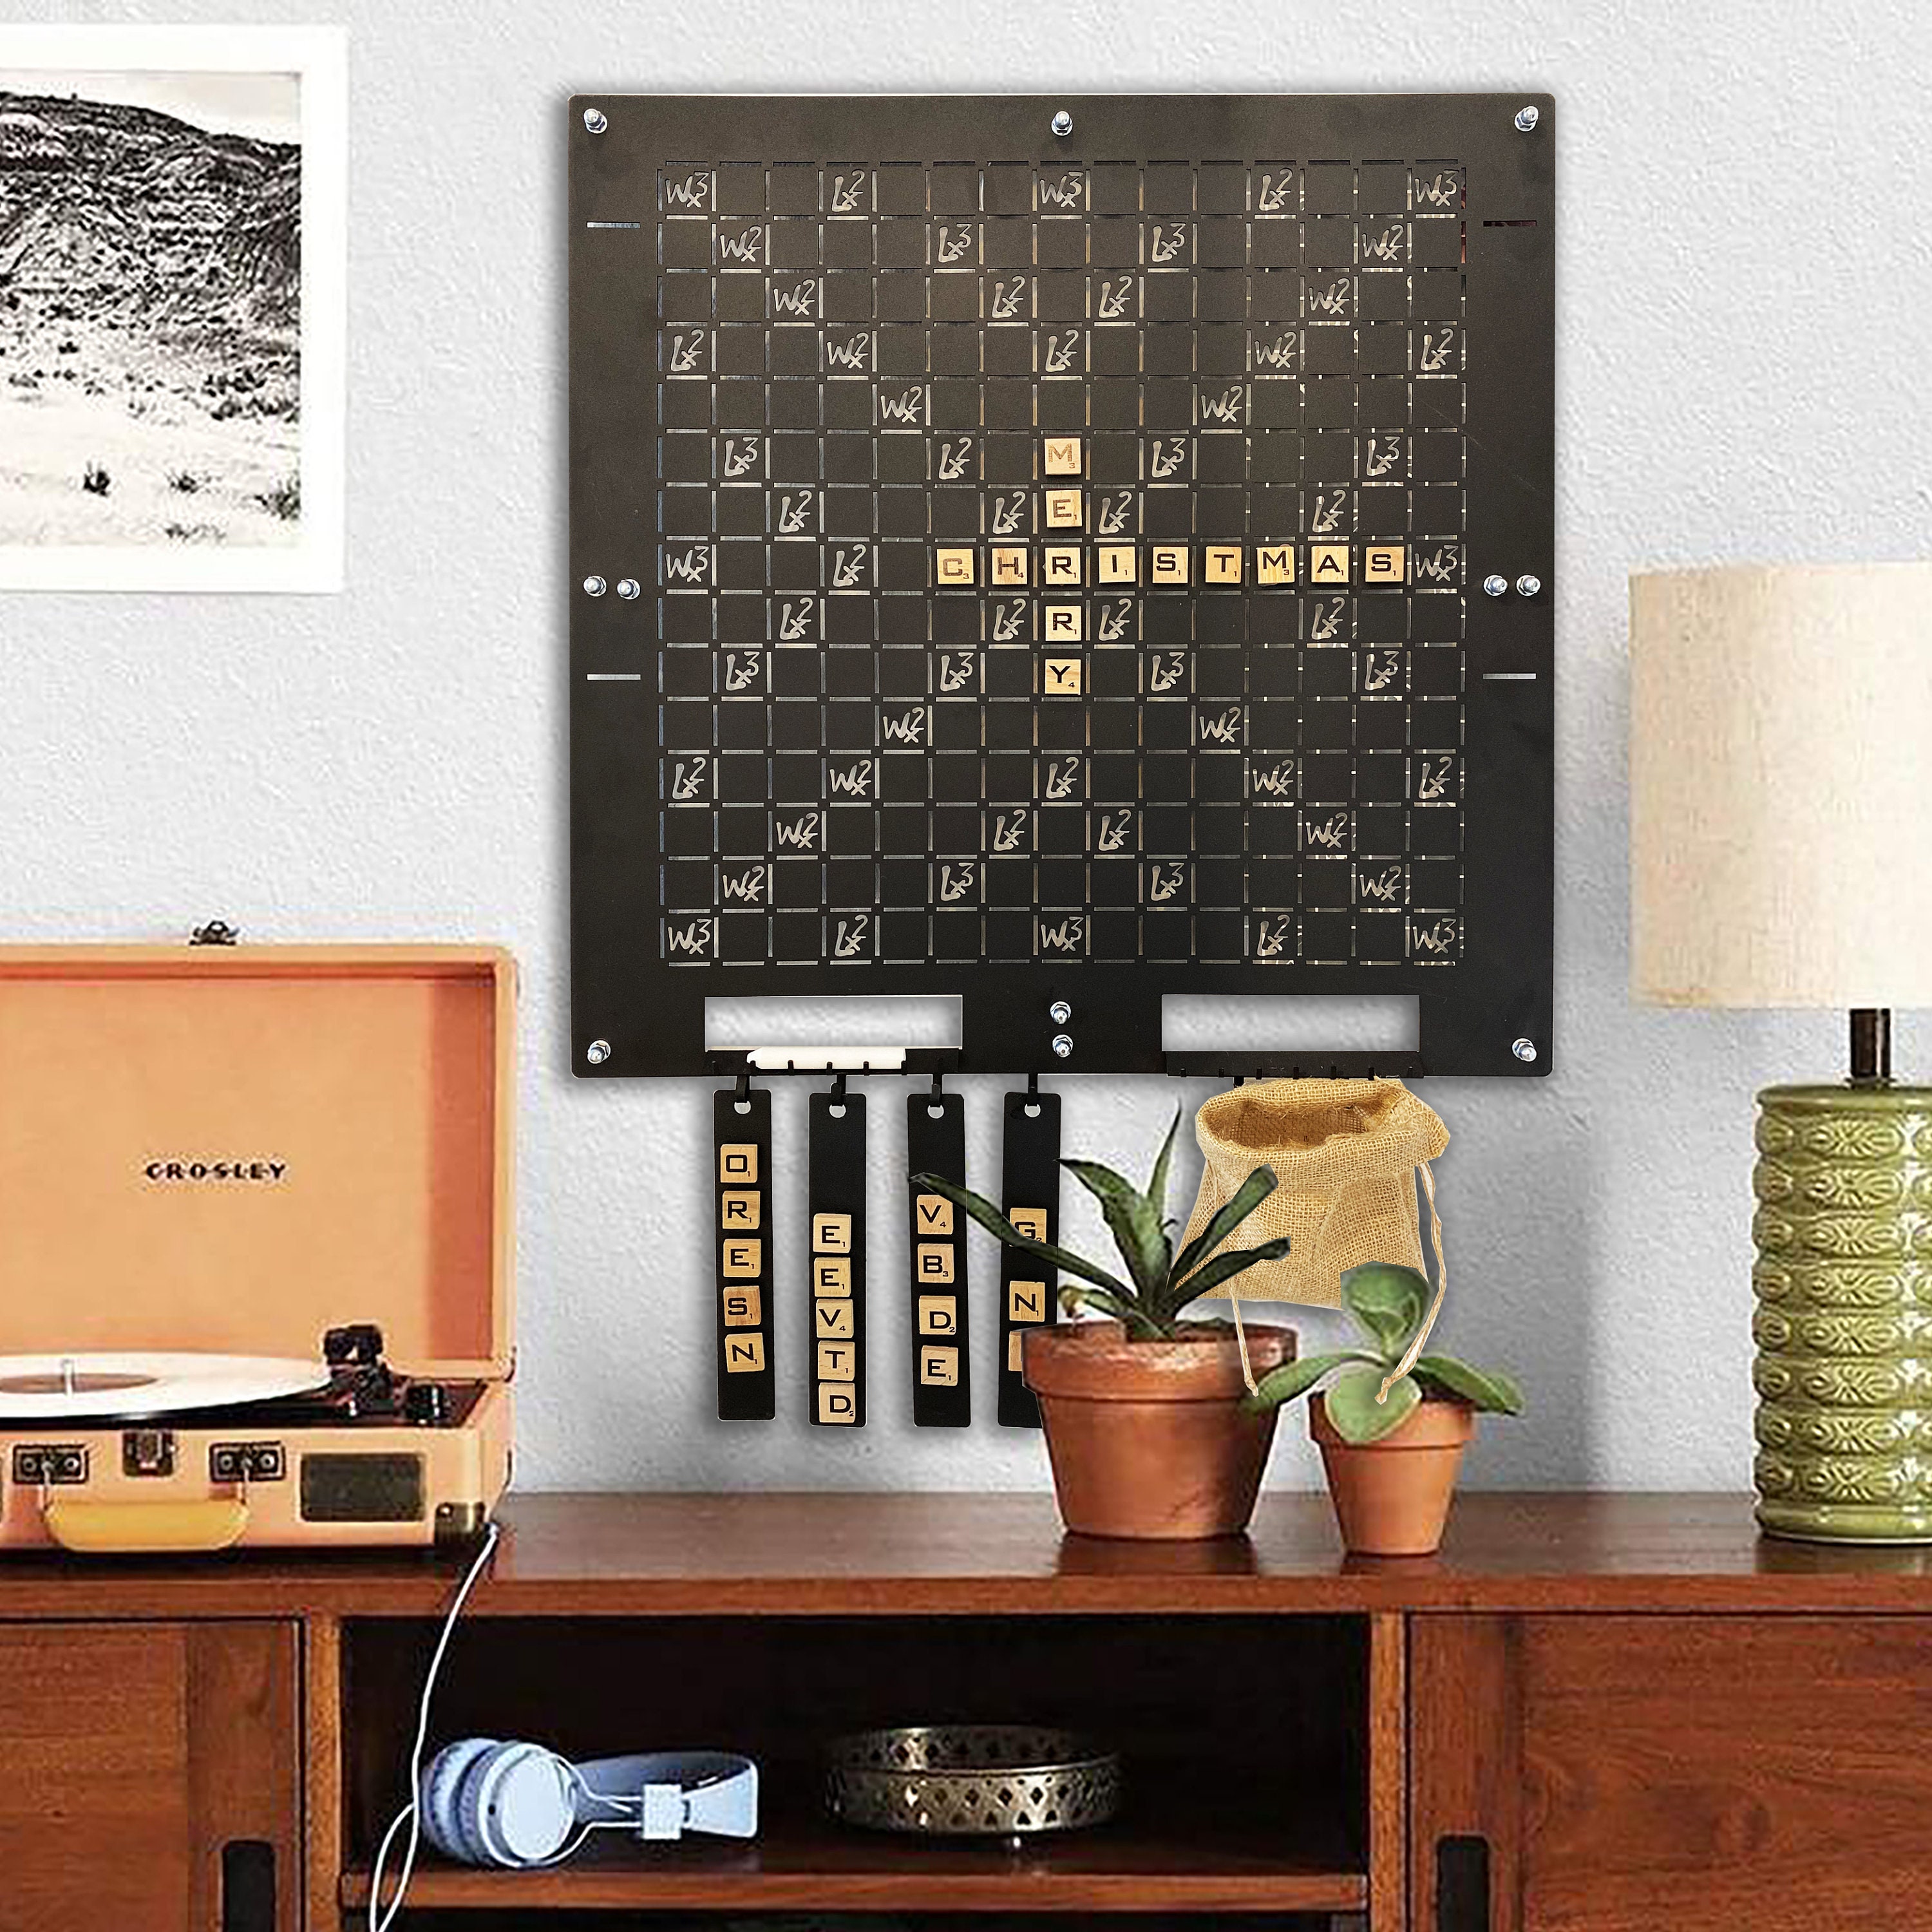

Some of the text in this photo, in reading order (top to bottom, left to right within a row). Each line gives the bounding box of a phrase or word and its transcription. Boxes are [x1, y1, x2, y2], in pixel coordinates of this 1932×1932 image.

[943, 551, 1392, 576] CHRISTMAS
[146, 1163, 285, 1179] CROSLEY
[726, 1155, 748, 1173] O
[727, 1200, 748, 1219] R
[920, 1204, 942, 1223] V
[821, 1226, 840, 1244] E
[730, 1248, 750, 1266] E
[923, 1255, 943, 1274] B
[820, 1268, 840, 1286] E
[728, 1297, 748, 1316] S
[1015, 1293, 1036, 1312] N
[819, 1309, 842, 1327] V
[929, 1311, 951, 1330] D
[732, 1343, 753, 1362] N
[824, 1350, 845, 1369] T
[927, 1359, 947, 1378] E
[829, 1395, 851, 1413] D
